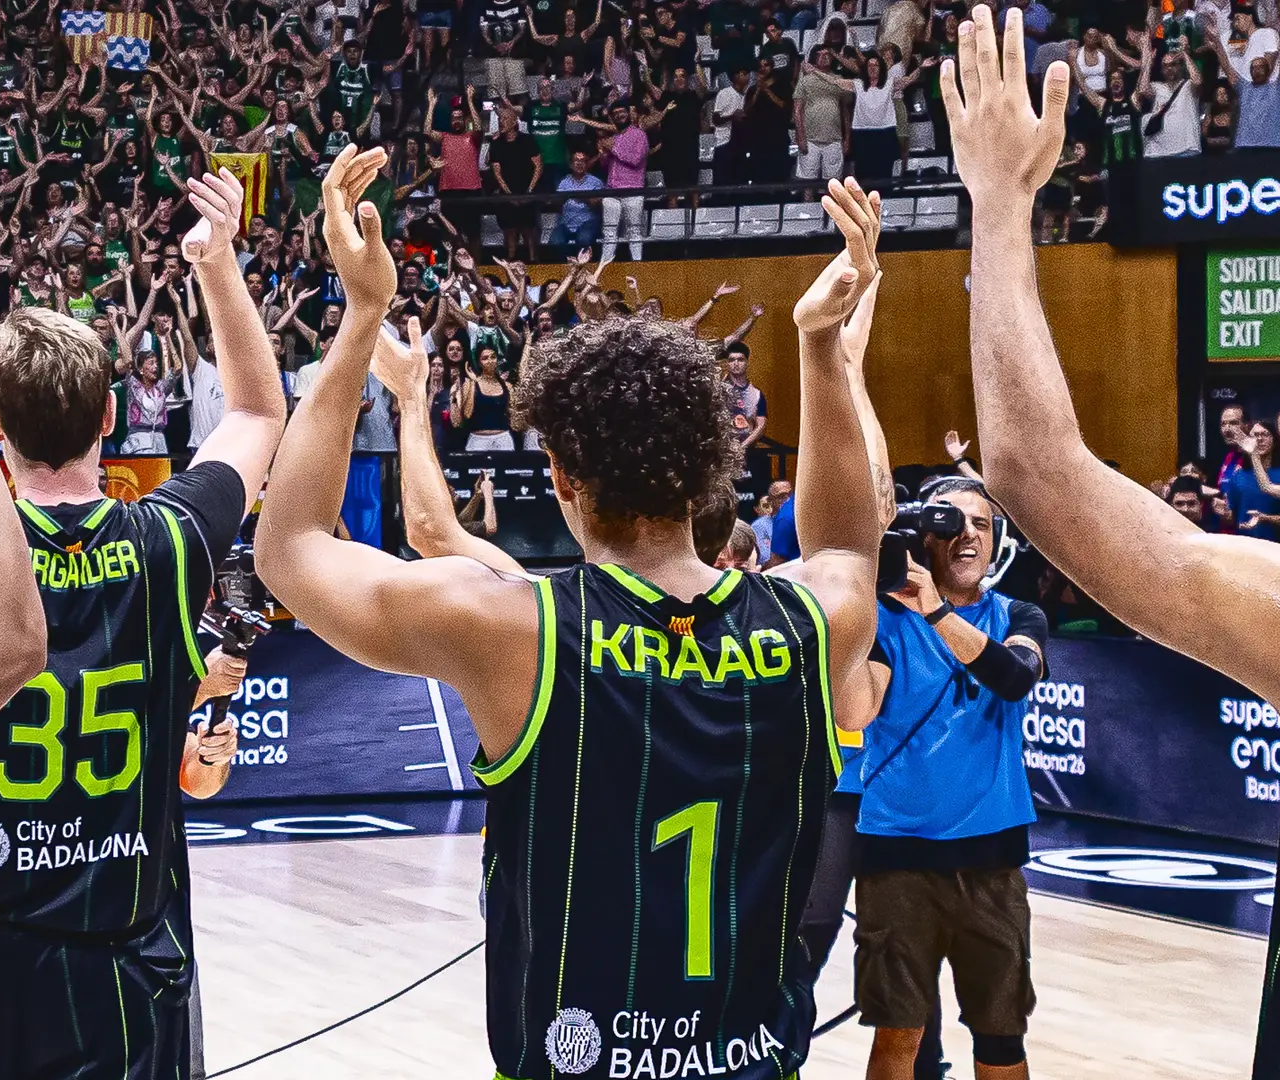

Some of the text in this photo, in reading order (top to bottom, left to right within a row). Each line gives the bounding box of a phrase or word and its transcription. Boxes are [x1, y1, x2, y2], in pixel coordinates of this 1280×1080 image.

[1219, 320, 1264, 349] EXIT
[590, 616, 794, 685] KRAAG
[16, 817, 83, 848] City of
[17, 832, 150, 873] BADALONA
[654, 800, 721, 980] 1
[612, 1009, 702, 1042] City of
[609, 1023, 785, 1080] BADALONA
